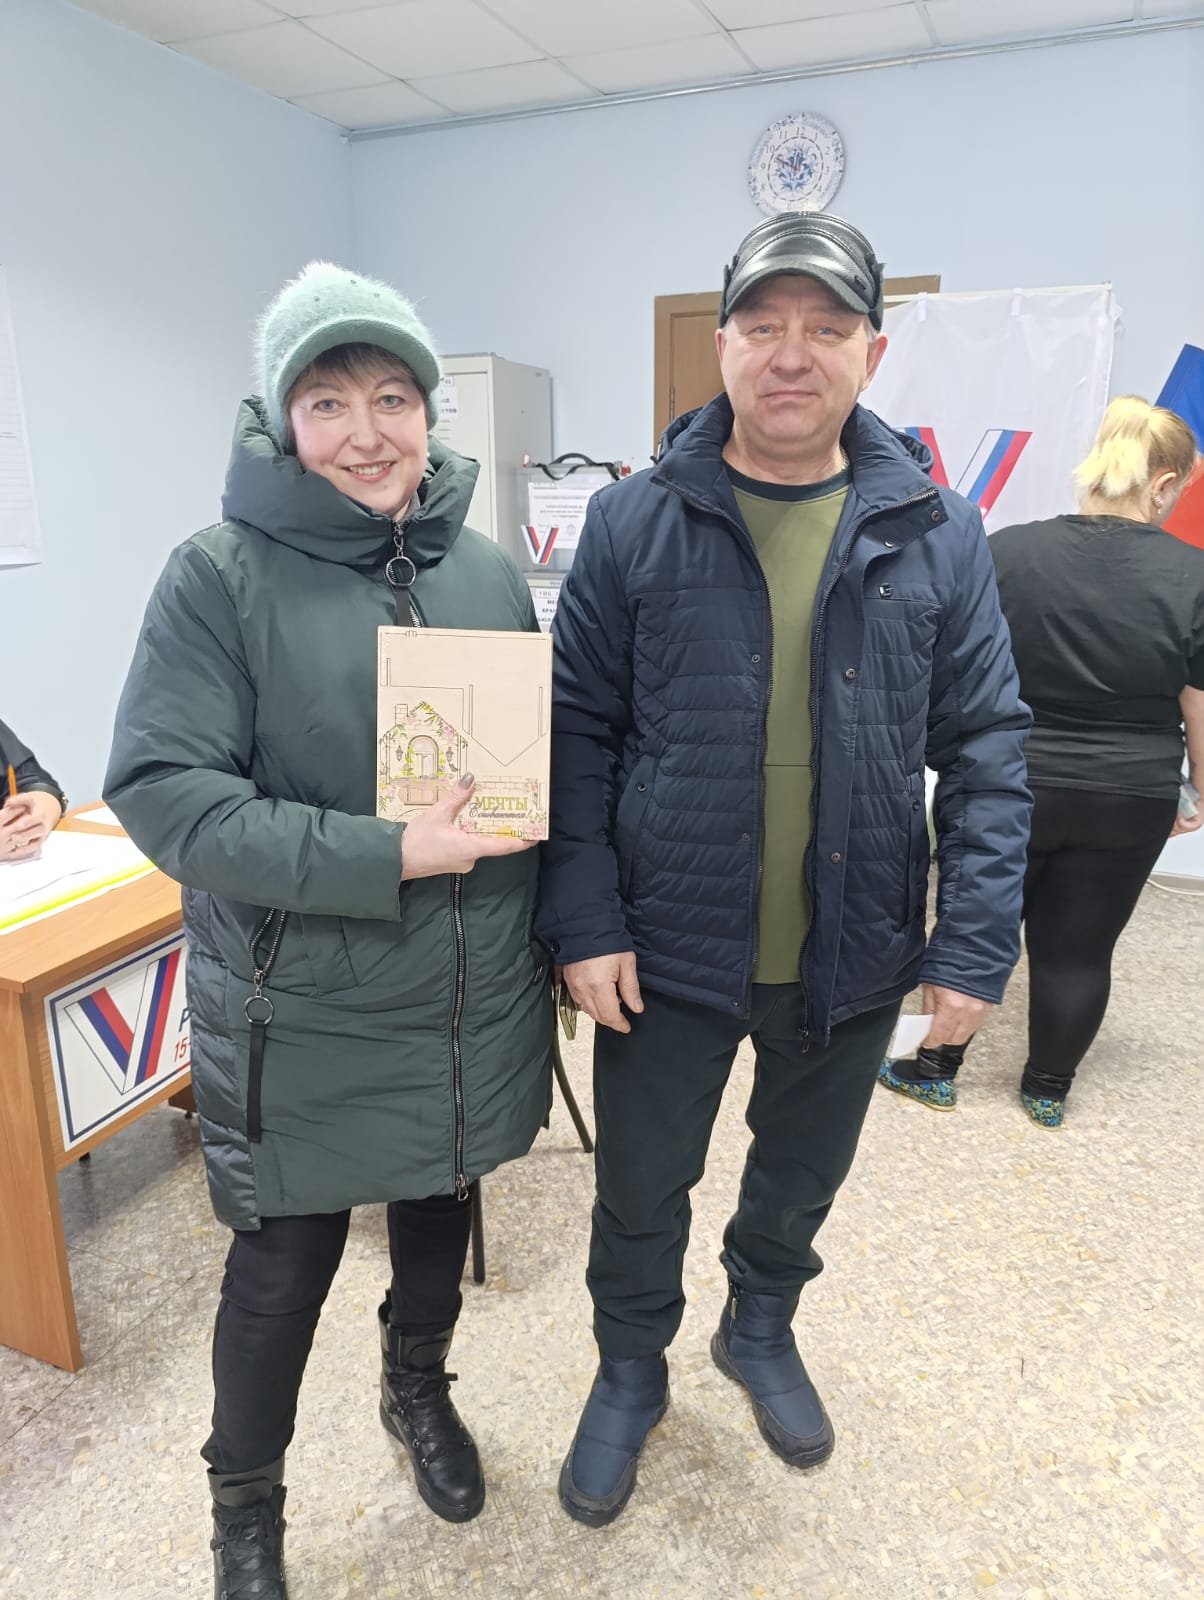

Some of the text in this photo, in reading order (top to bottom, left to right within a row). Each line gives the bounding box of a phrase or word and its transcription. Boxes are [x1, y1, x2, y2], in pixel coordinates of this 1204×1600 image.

[474, 796, 529, 811] МЕЧТЫ
[178, 1007, 191, 1033] Р
[174, 1036, 191, 1063] 15-
